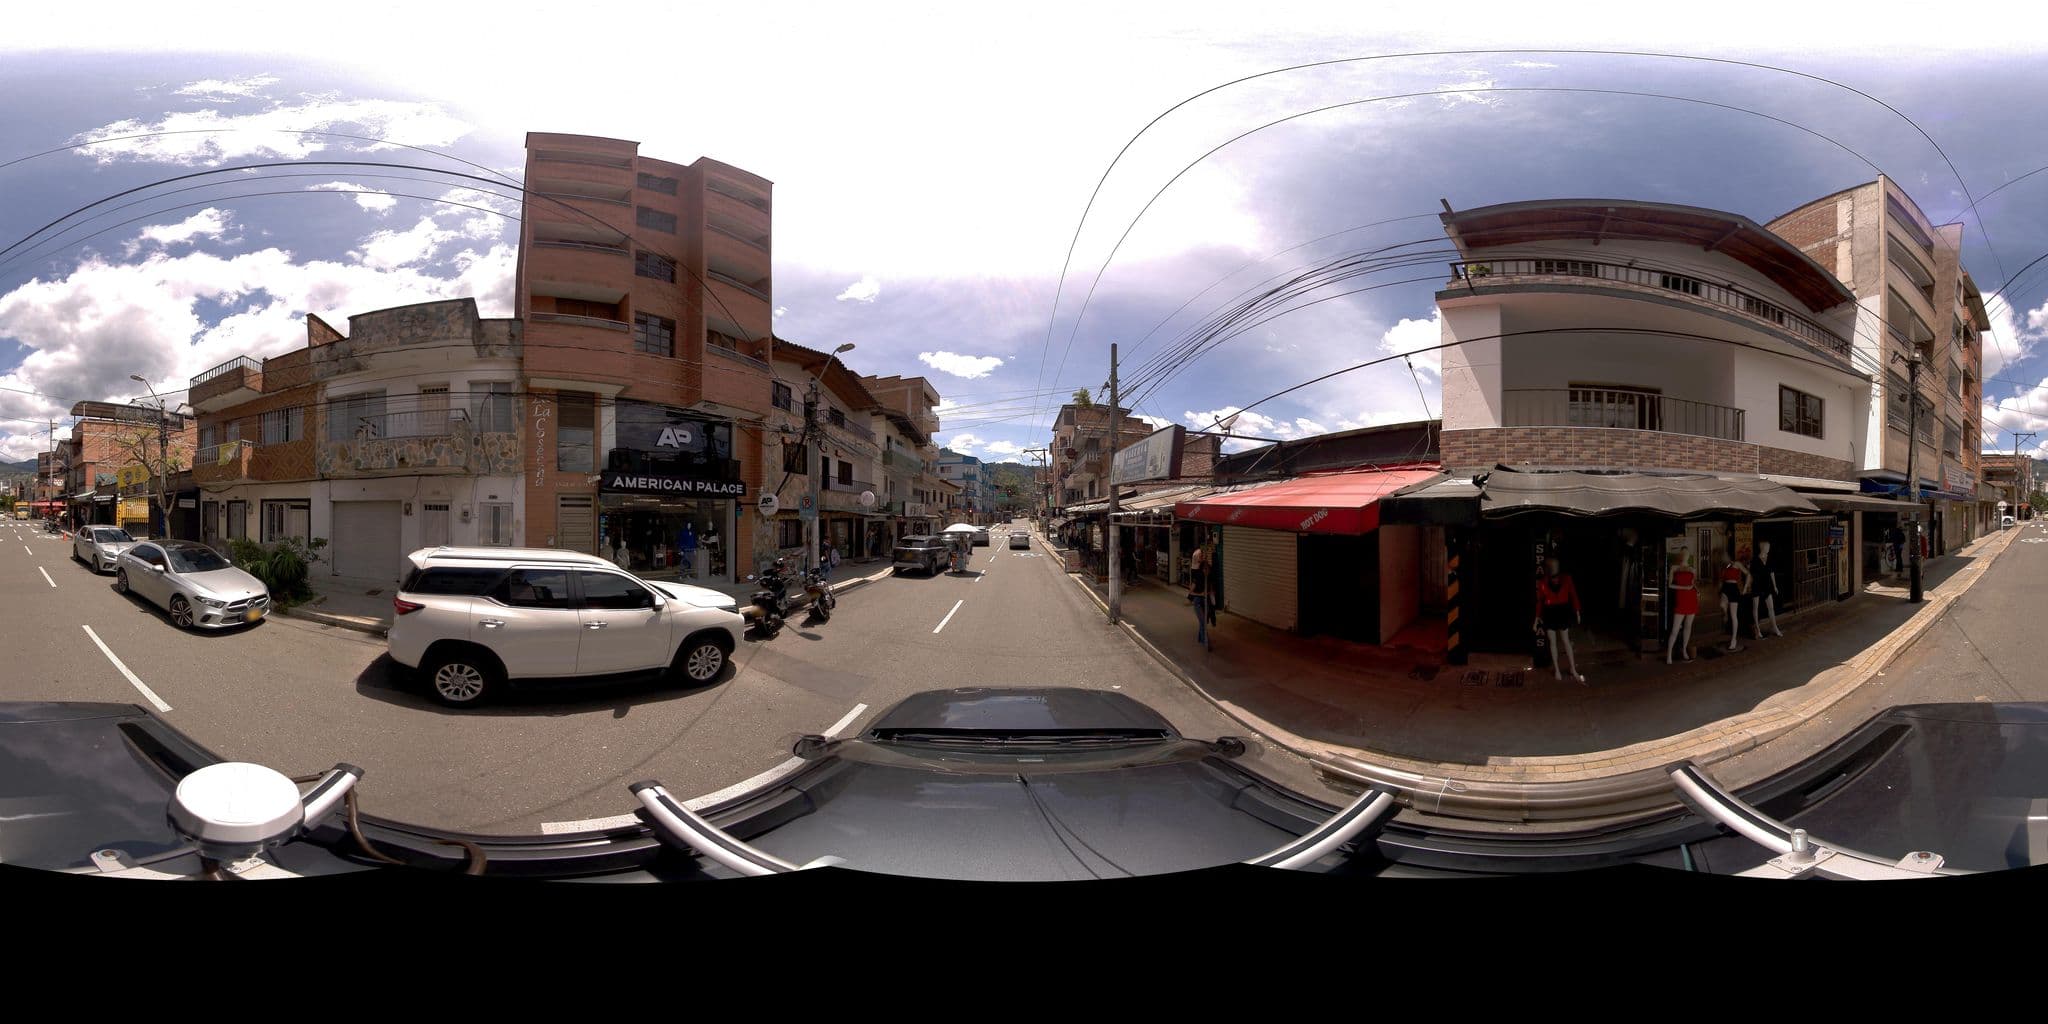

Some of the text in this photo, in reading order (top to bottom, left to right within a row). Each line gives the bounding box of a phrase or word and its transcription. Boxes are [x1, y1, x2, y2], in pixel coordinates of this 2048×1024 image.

[532, 404, 552, 417] La
[656, 427, 692, 449] AP
[613, 476, 744, 495] AMERICAN PALACE
[760, 497, 773, 505] AP
[1300, 516, 1315, 531] HOT
[1535, 544, 1545, 575] SPA
